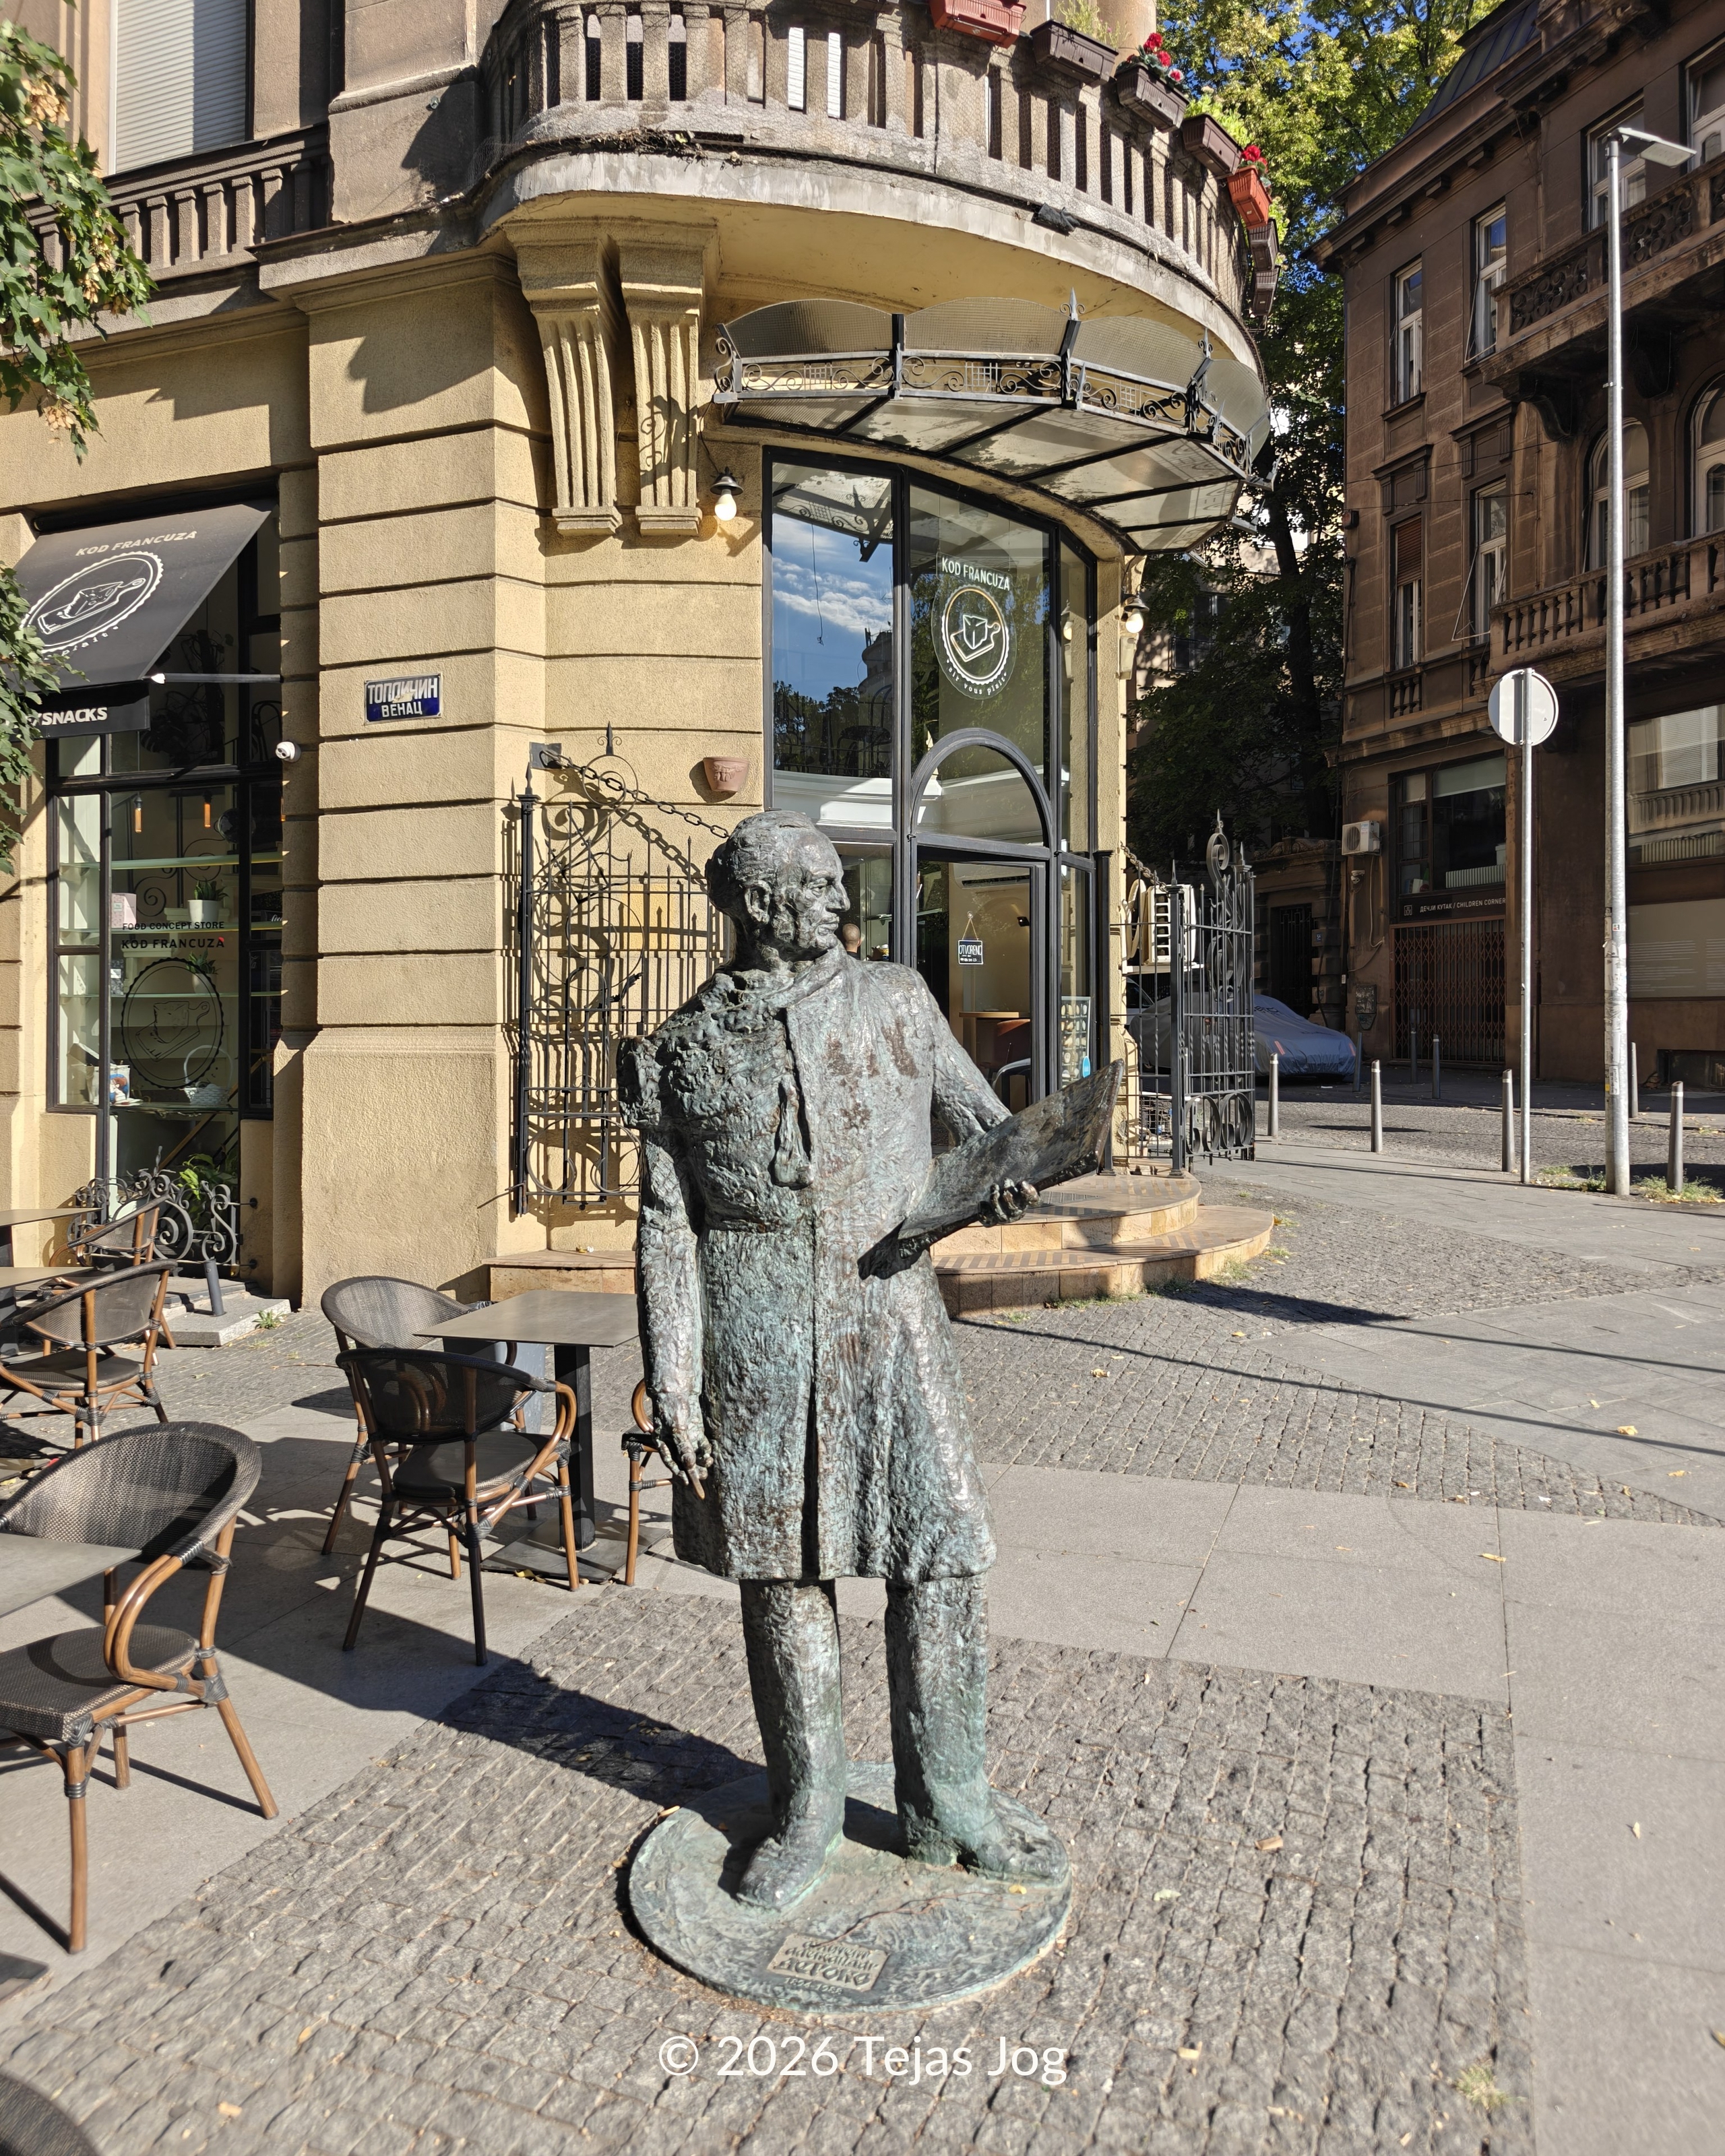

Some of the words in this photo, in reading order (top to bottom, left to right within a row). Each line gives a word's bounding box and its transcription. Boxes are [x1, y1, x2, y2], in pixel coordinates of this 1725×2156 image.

[75, 544, 109, 556] KOD
[111, 531, 197, 550] FRANCUZA
[942, 557, 961, 575] KOD
[963, 564, 1010, 591] FRANCUZA
[964, 683, 982, 695] vous
[381, 701, 423, 718] ВЕНАЦ
[1456, 899, 1483, 908] CHILDREN
[1484, 897, 1507, 906] CORNER
[149, 922, 192, 930] CONCEPT
[194, 921, 225, 929] STORE
[121, 939, 148, 949] KOD
[152, 937, 225, 949] FRANCUZA
